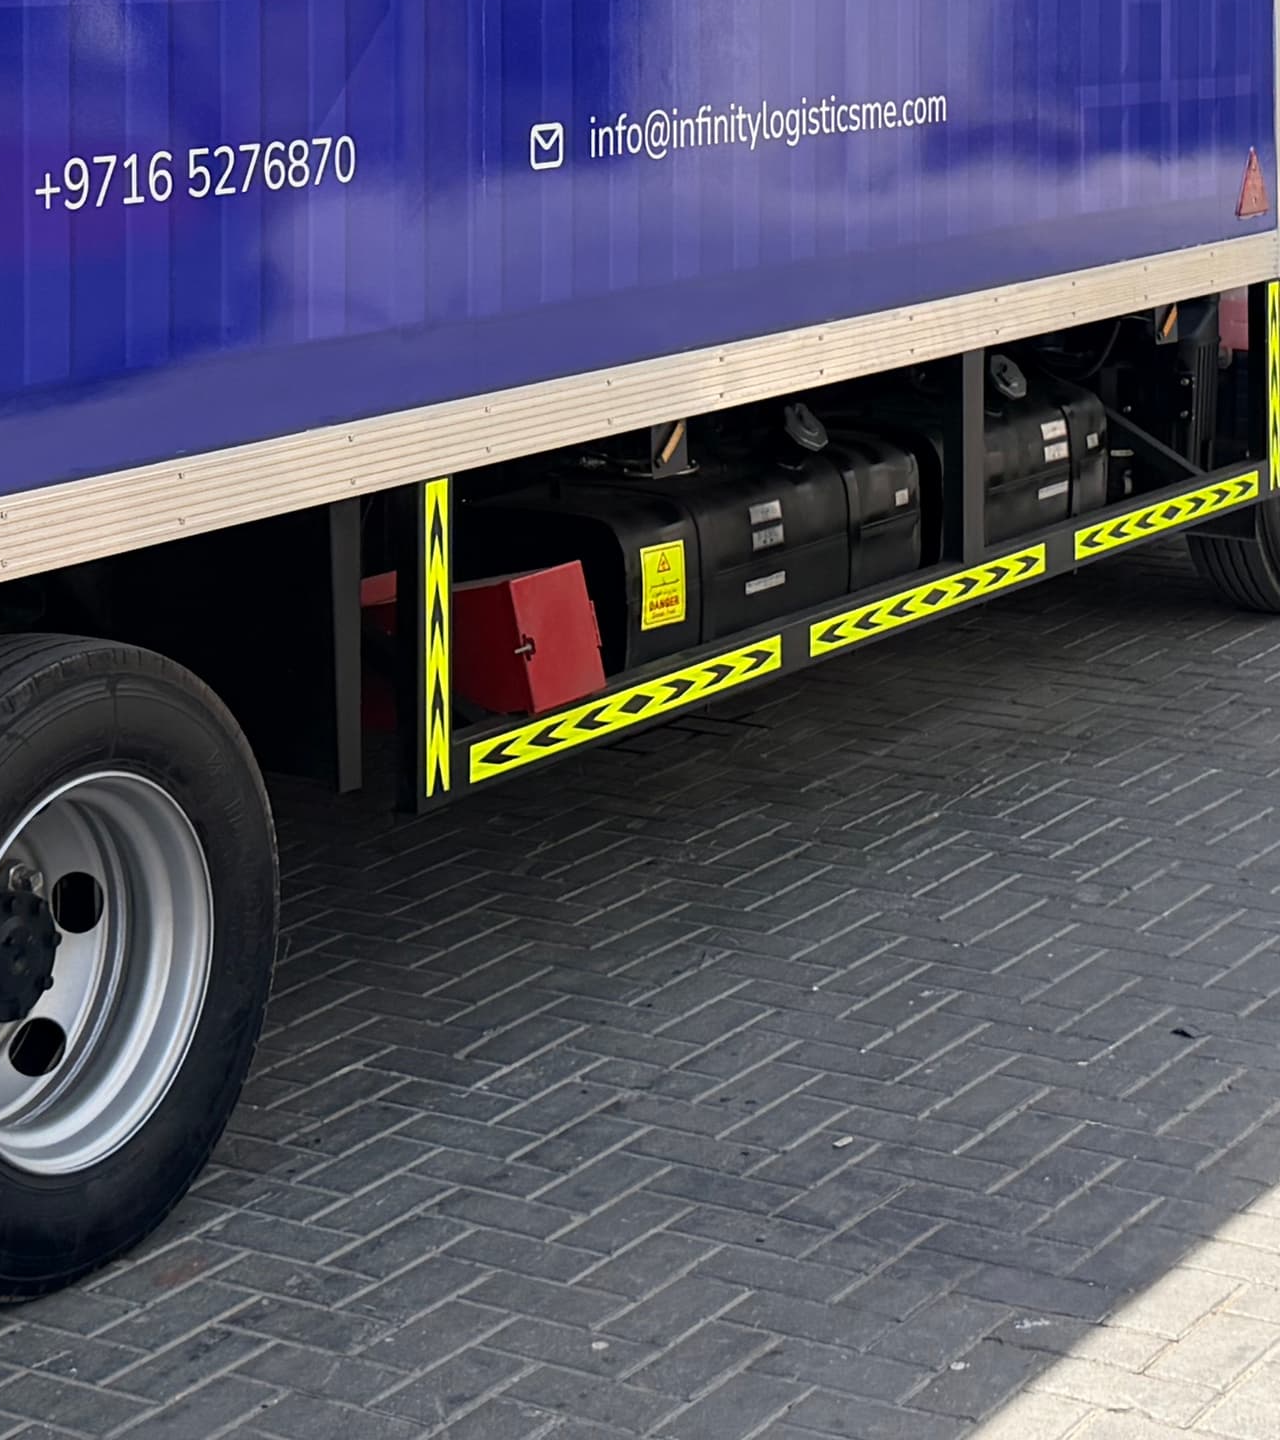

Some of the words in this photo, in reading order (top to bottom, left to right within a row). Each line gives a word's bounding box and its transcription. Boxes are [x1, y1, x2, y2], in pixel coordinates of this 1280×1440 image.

[589, 94, 947, 160] info@infinitylogisticsme.com
[35, 150, 173, 210] +9716
[187, 135, 356, 198] 5276870
